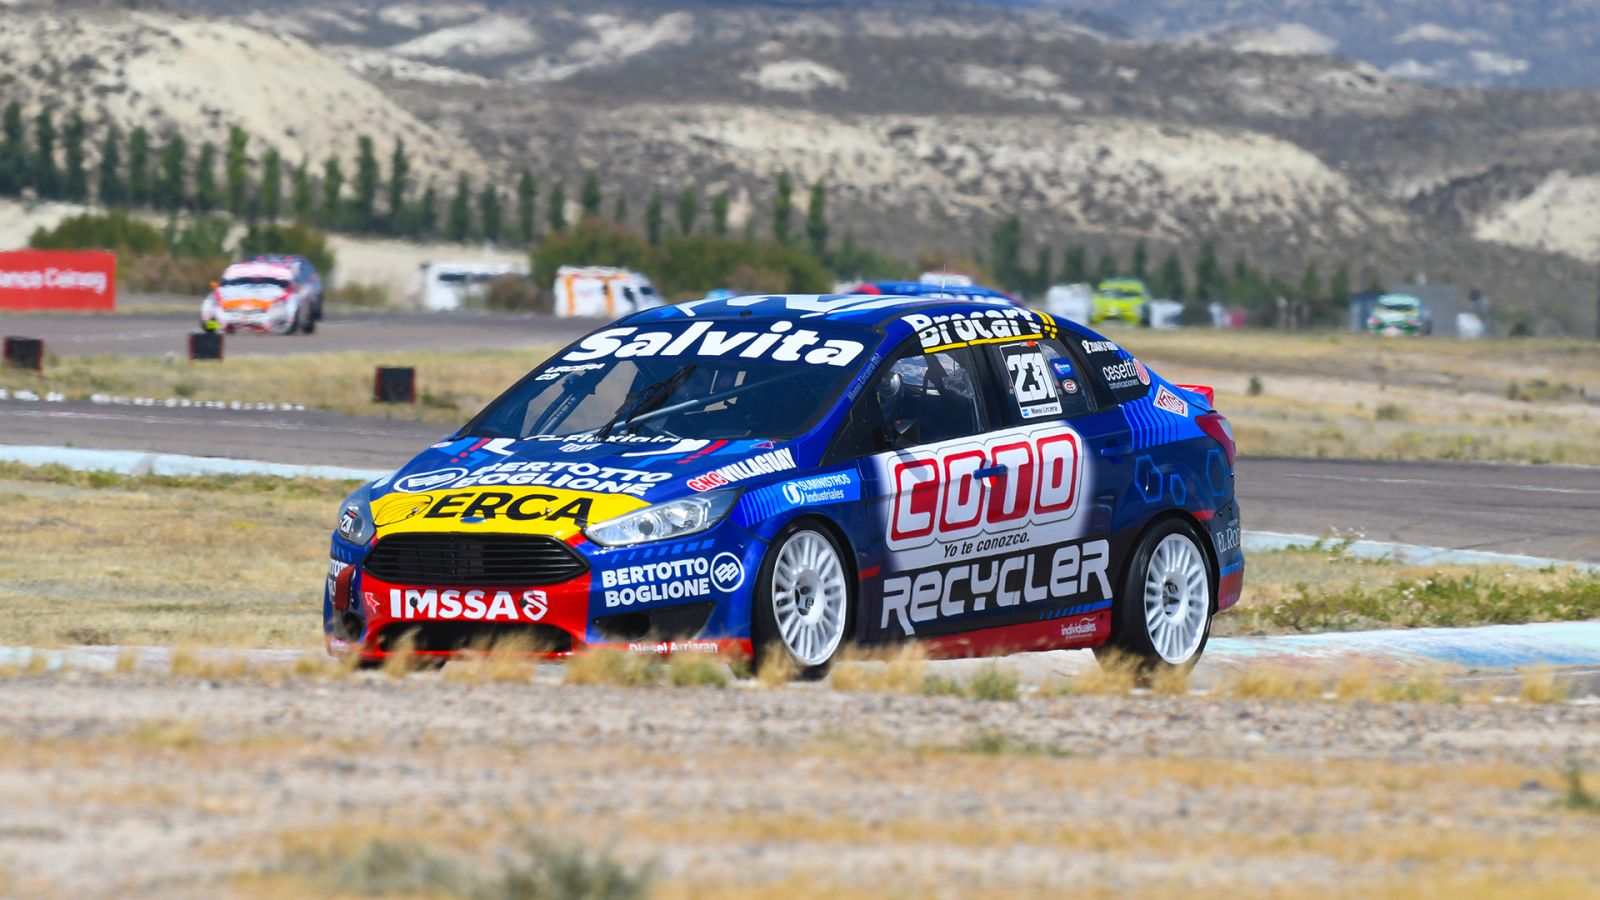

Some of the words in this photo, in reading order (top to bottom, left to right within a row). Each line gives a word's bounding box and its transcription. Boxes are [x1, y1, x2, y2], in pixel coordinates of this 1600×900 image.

[563, 320, 864, 366] Salvita
[901, 307, 1041, 348] Brocart
[450, 473, 656, 497] BOGLIONE
[470, 461, 673, 482] BERTOTTO
[891, 433, 1081, 542] COTO
[424, 492, 594, 524] ERCA
[944, 543, 958, 558] Yo
[961, 541, 973, 555] te
[976, 532, 1030, 552] conozco.
[601, 557, 709, 588] BERTOTTO
[390, 589, 519, 620] IMSSA
[604, 577, 711, 607] BOGLIONE
